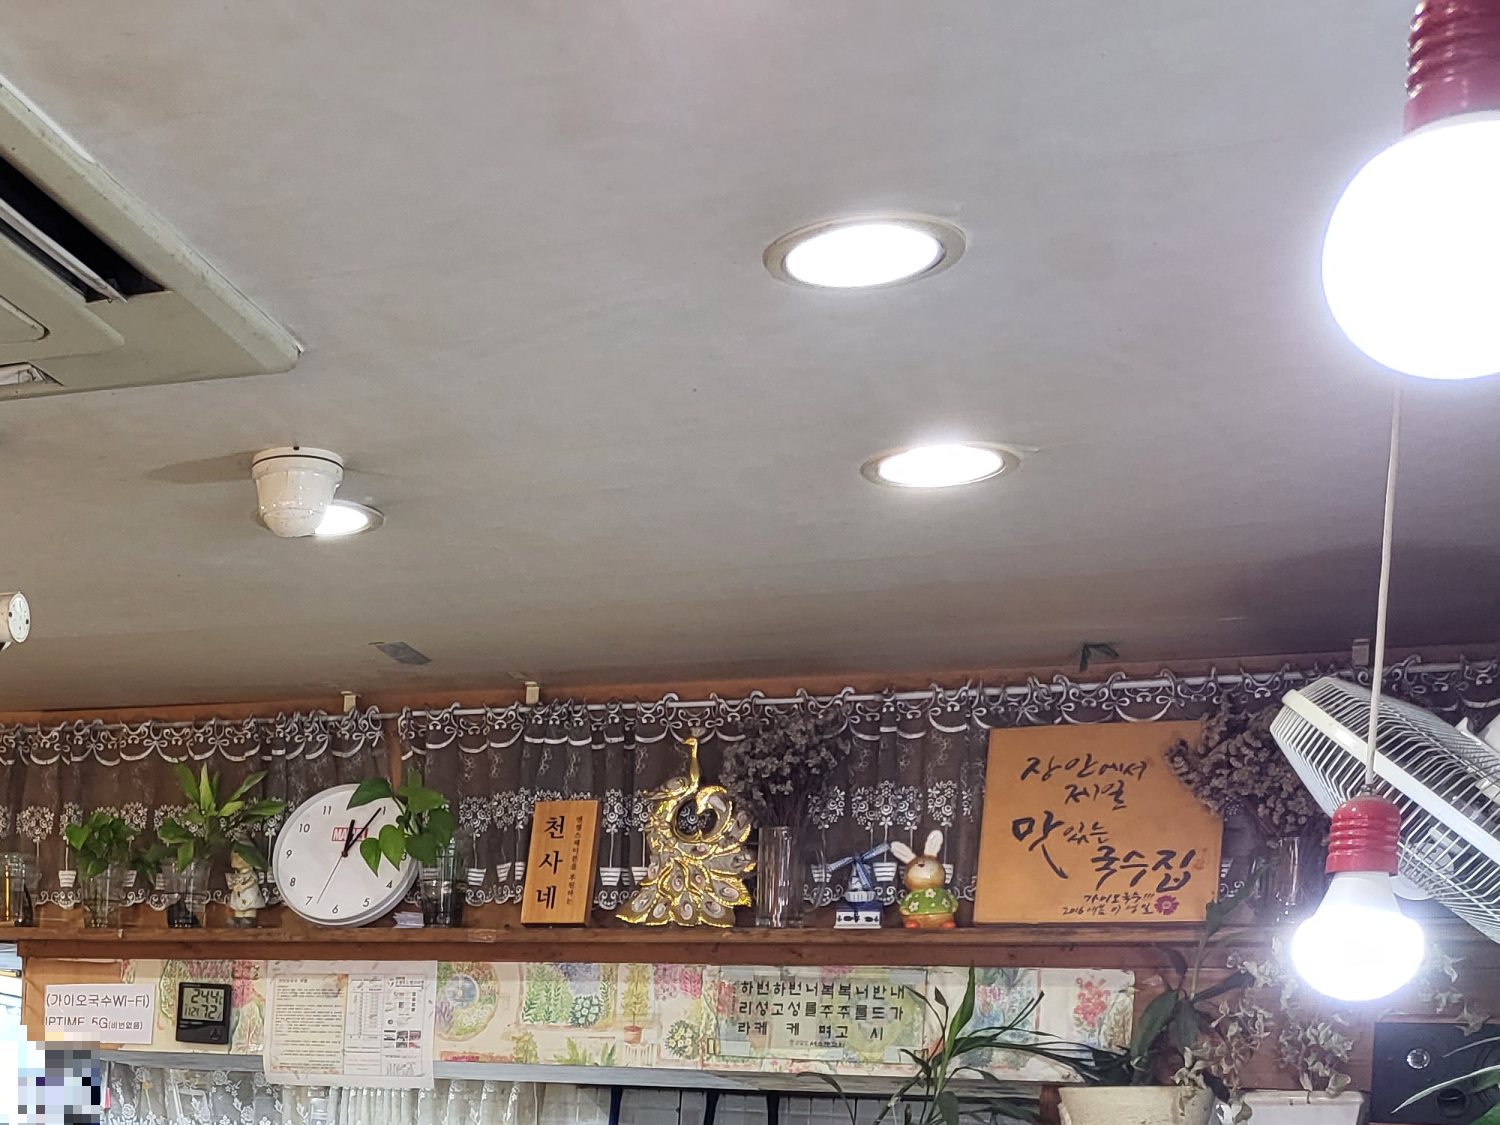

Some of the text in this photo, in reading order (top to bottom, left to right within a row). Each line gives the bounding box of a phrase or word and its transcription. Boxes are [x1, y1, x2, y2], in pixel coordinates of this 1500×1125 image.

[323, 806, 331, 815] 11
[299, 824, 310, 833] 10
[286, 850, 292, 859] 9
[1091, 845, 1196, 893] 국수집
[290, 877, 296, 887] 8
[386, 880, 393, 888] 4
[306, 896, 313, 905] 7
[363, 898, 369, 907] 5
[332, 905, 338, 914] 6
